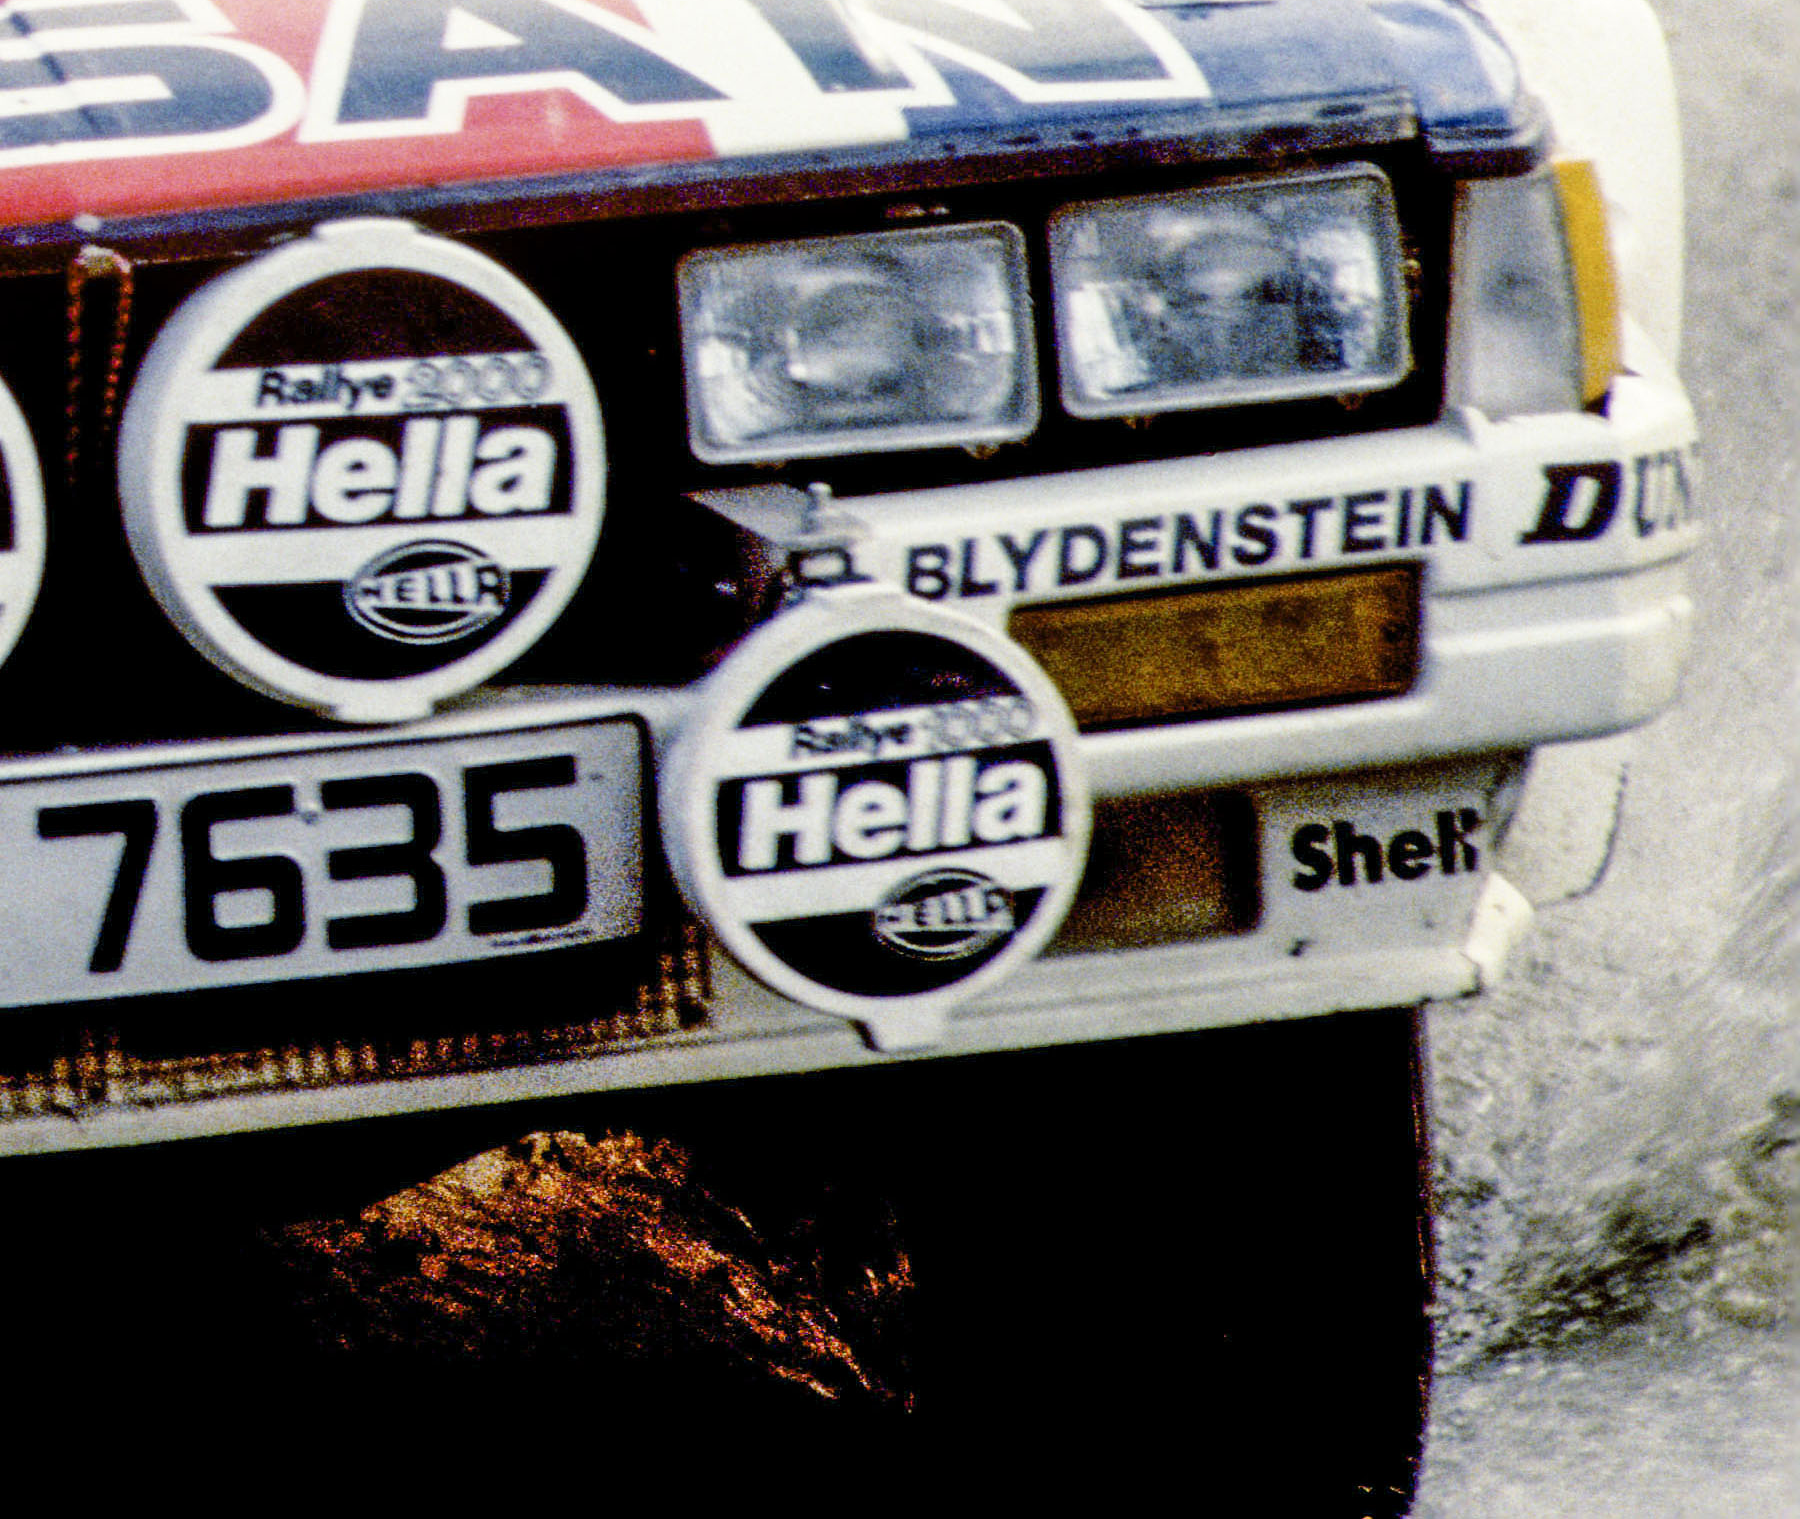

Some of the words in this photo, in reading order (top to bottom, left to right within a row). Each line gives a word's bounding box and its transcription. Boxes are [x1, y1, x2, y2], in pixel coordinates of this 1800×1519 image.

[255, 365, 395, 415] Rallye
[204, 415, 558, 528] Hella
[907, 481, 1473, 603] BLYDENSTEIN
[36, 753, 591, 974] 7635
[738, 755, 1047, 870] Hella
